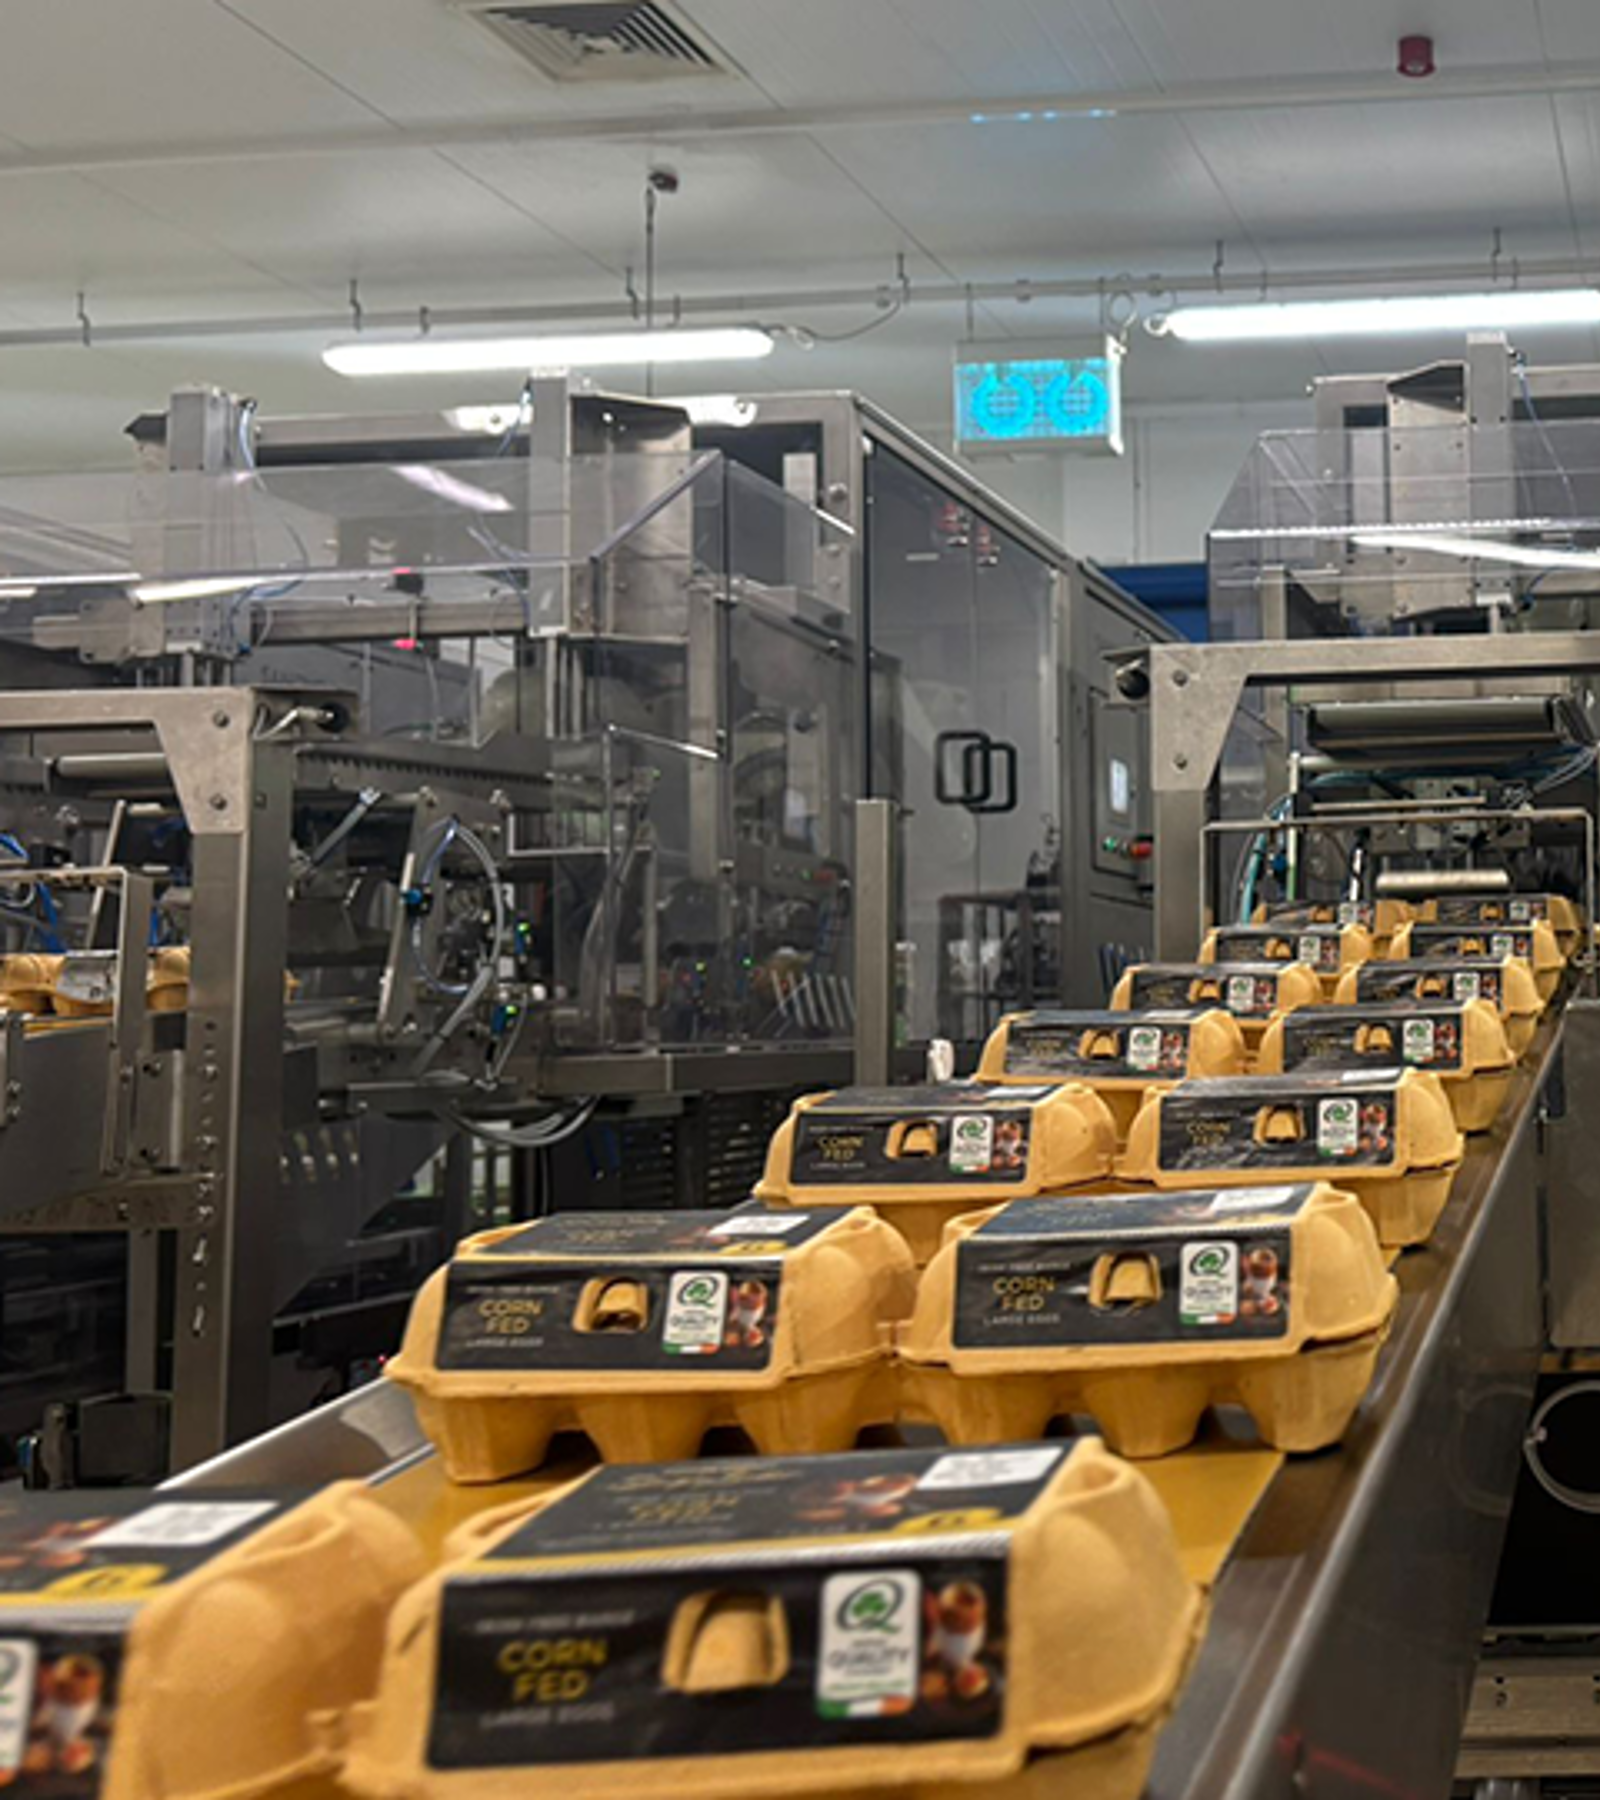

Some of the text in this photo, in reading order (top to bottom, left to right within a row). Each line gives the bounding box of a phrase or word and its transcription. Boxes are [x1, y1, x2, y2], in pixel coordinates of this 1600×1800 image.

[992, 1276, 1055, 1295] CORN
[479, 1299, 544, 1317] CORN
[497, 1638, 608, 1675] CORN
[512, 1669, 588, 1702] FED
